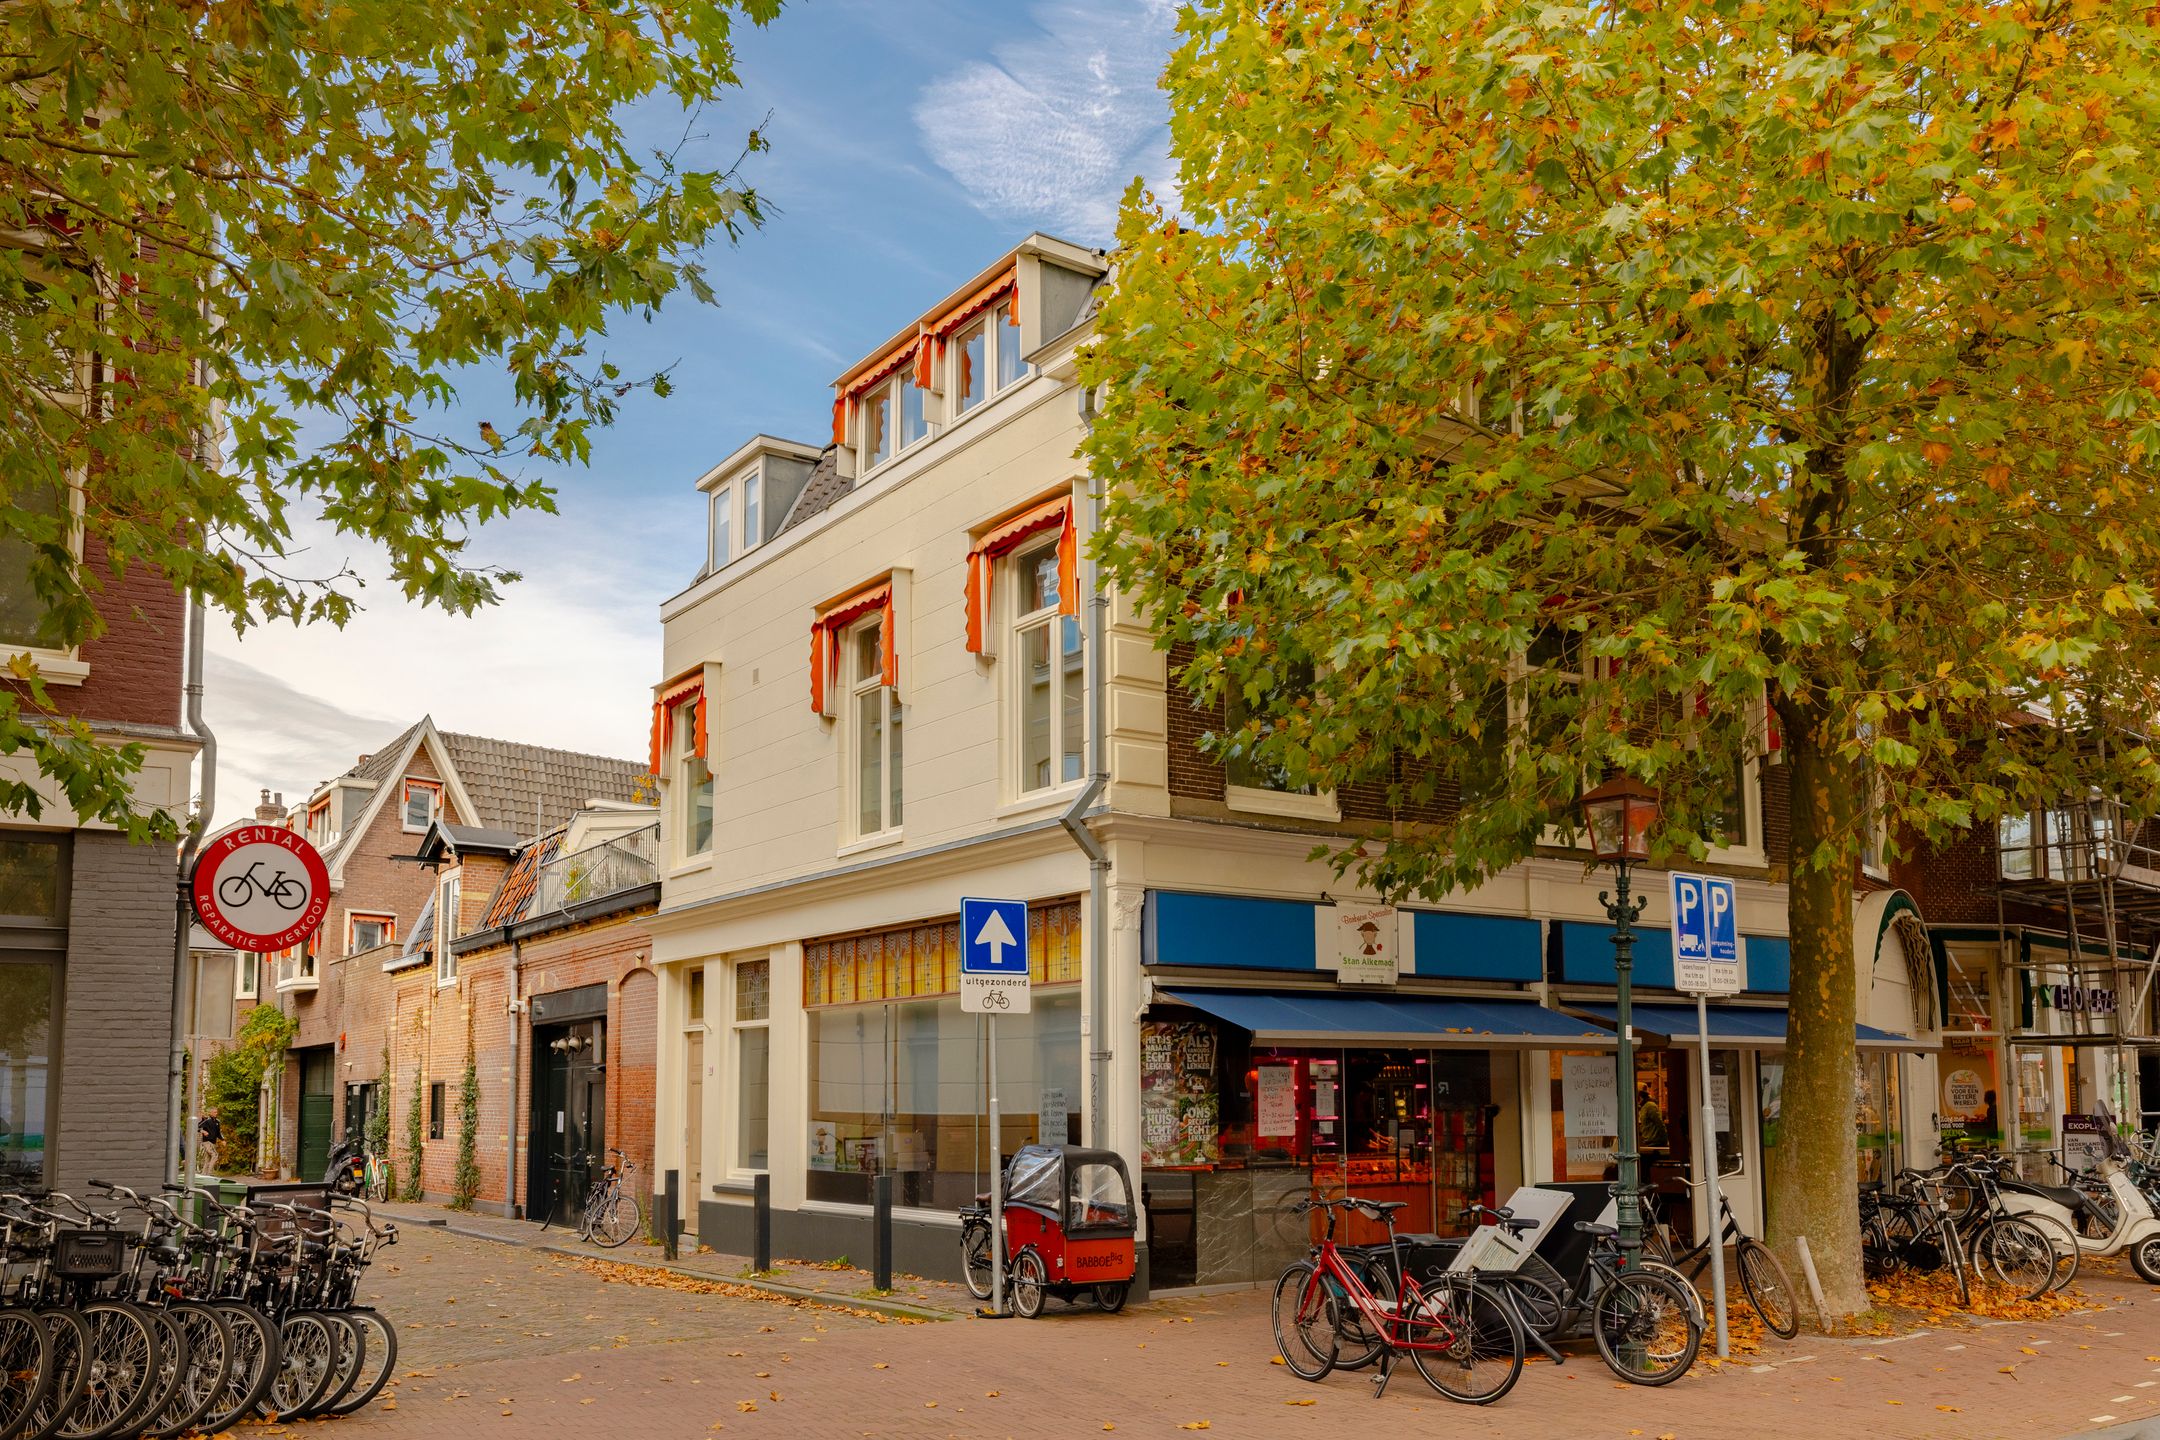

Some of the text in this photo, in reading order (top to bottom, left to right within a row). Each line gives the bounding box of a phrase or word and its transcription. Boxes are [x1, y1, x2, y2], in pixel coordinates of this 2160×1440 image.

[223, 828, 305, 855] RENTAL
[1680, 882, 1698, 924] P
[1711, 886, 1729, 927] P
[199, 895, 258, 948] REPARATIE
[276, 897, 324, 946] VERKOOP
[1343, 957, 1360, 965] Stan
[966, 977, 1027, 987] uitgezonderd
[1145, 1035, 1172, 1044] HET IS
[1187, 1035, 1210, 1047] ALS
[1145, 1052, 1172, 1062] ECHT
[1187, 1053, 1210, 1062] ECHT
[1145, 1062, 1172, 1070] LEKKER
[1147, 1114, 1172, 1125] HUIS
[1147, 1126, 1172, 1135] ECHT
[1188, 1126, 1210, 1134] ECHT
[1188, 1134, 1210, 1142] LEKKER
[1076, 1252, 1123, 1268] BABBOE Big
